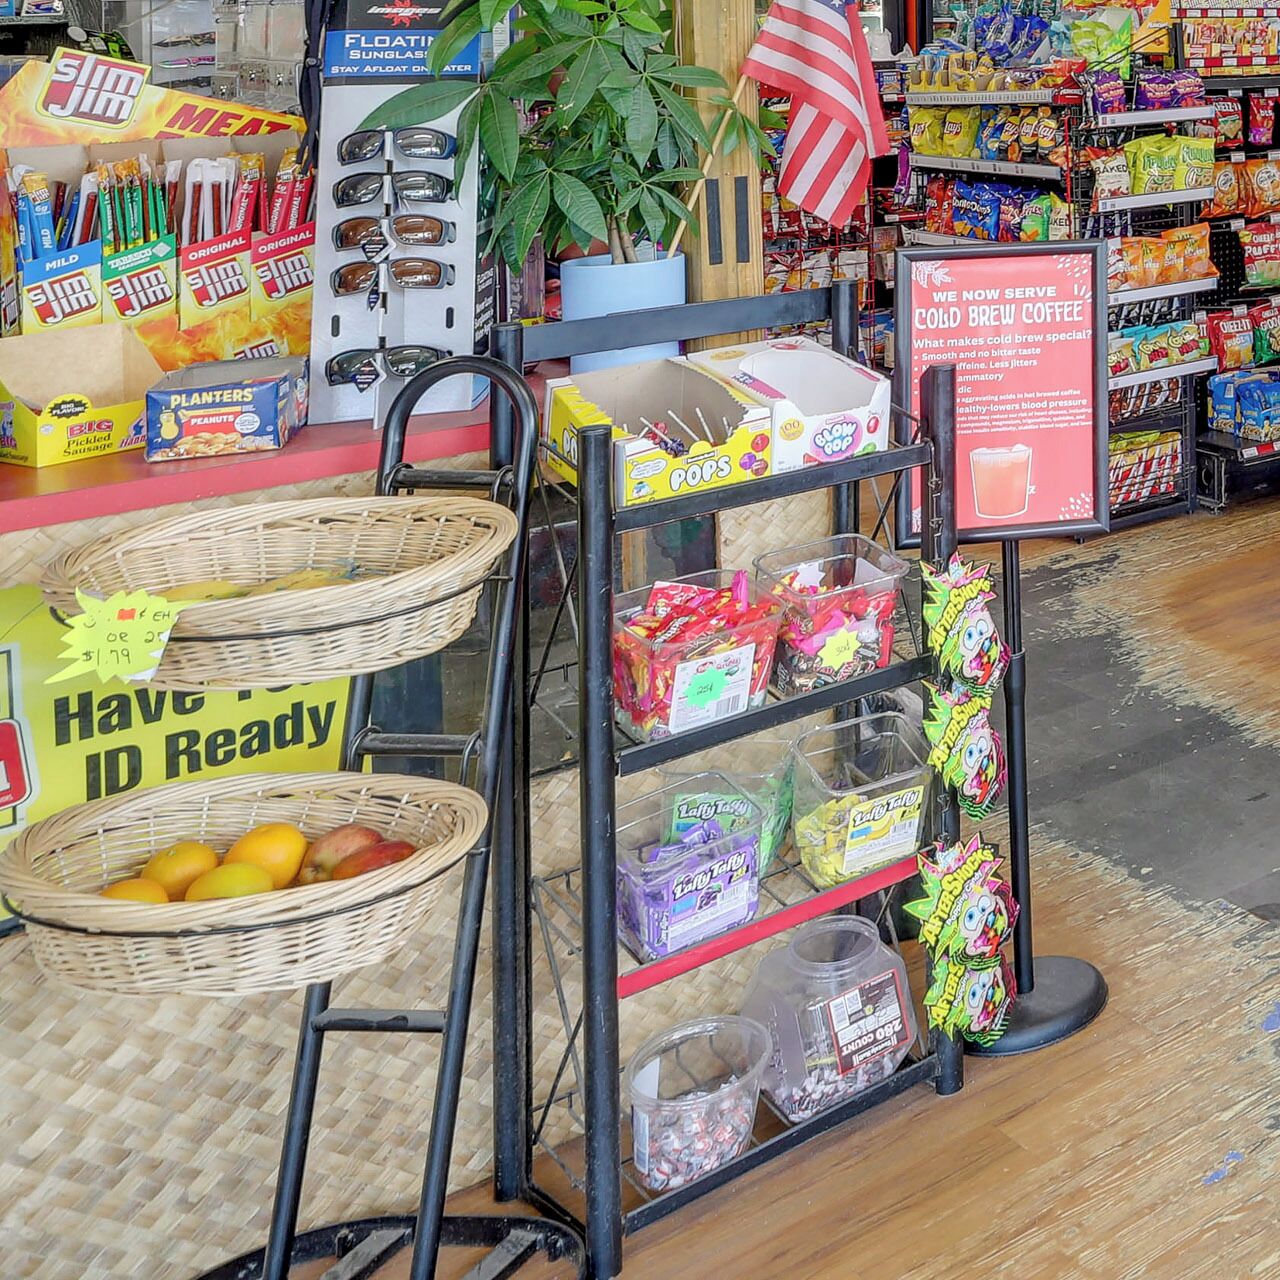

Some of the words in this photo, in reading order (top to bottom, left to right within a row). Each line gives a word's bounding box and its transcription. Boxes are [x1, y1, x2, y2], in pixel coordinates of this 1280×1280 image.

[344, 34, 434, 47] FLOATIN
[350, 50, 428, 59] SUNGLASS
[331, 65, 359, 74] STAY
[363, 64, 408, 73] AFLOAT
[944, 120, 962, 135] Lay's
[188, 237, 246, 261] ORIGINAL
[257, 229, 313, 254] ORIGINAL
[45, 253, 79, 272] MILD
[932, 291, 957, 302] WE
[962, 289, 1000, 301] NOW
[1004, 286, 1057, 298] SERVE
[914, 307, 961, 329] COLD
[968, 303, 1016, 327] BREW
[1022, 301, 1083, 324] COFFEE
[913, 338, 945, 349] What
[947, 336, 985, 347] makes
[987, 334, 1012, 344] cold
[1015, 332, 1043, 343] brew
[1045, 329, 1092, 344] special?
[922, 352, 957, 360] Smooth
[991, 348, 1016, 356] bitter
[1018, 347, 1041, 355] taste
[989, 361, 1009, 369] Less
[170, 388, 254, 408] PLANTERS
[956, 404, 1019, 414] ealthy-lowers
[1021, 401, 1047, 409] blood
[1049, 399, 1087, 410] pressure
[67, 421, 114, 436] BIG
[191, 414, 234, 426] PEANUTS
[67, 433, 112, 448] Pickled
[815, 422, 857, 446] BLOW
[62, 442, 114, 458] Sausage
[823, 435, 853, 456] POP
[670, 456, 731, 491] POPS
[82, 648, 130, 665] $1.79
[53, 689, 205, 747] Have
[165, 700, 337, 781] Ready
[85, 745, 142, 802] ID
[678, 803, 716, 820] Laffy
[714, 798, 749, 817] Taffy
[853, 802, 888, 828] Laffy
[886, 790, 920, 813] Taffy
[673, 871, 710, 901] Laffy
[709, 852, 747, 882] Taffy
[875, 1019, 902, 1040] 280
[841, 1033, 874, 1056] COUNT
